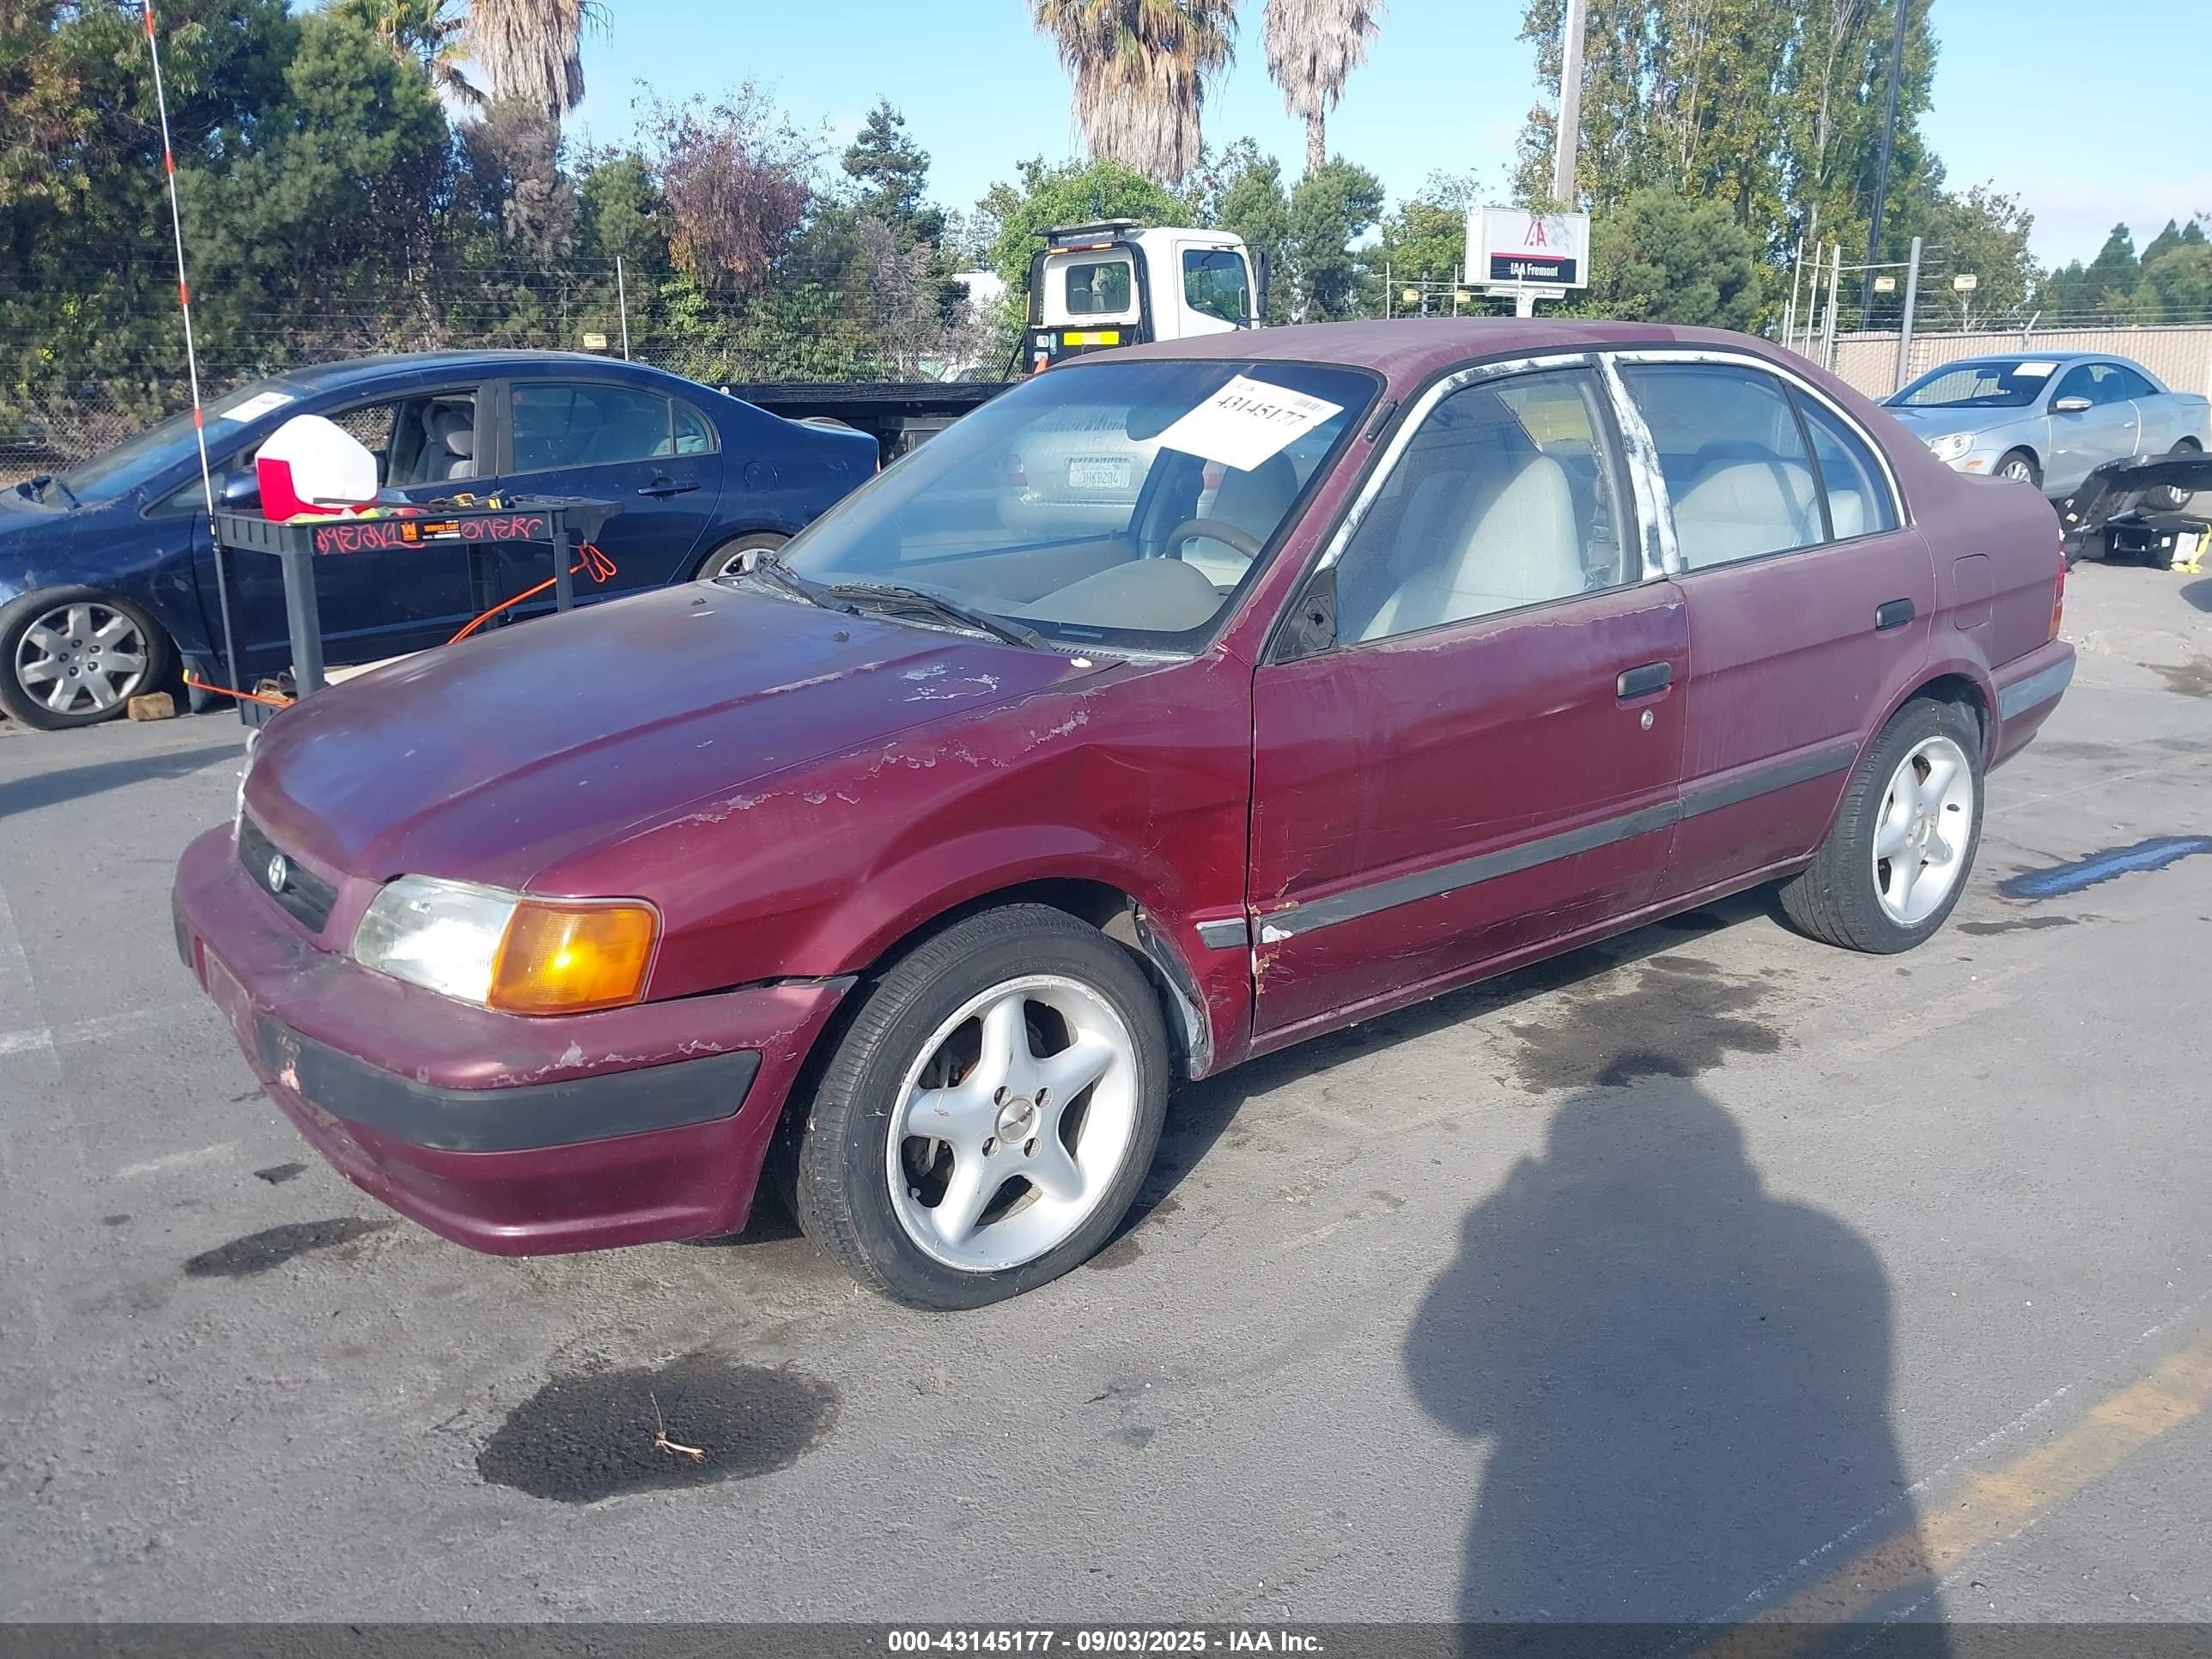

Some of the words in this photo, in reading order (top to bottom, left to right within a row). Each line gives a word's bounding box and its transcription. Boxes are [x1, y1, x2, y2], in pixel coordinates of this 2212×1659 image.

[1510, 262, 1526, 276] IAA
[1527, 263, 1559, 276] Fremont
[1217, 395, 1308, 426] 43145177
